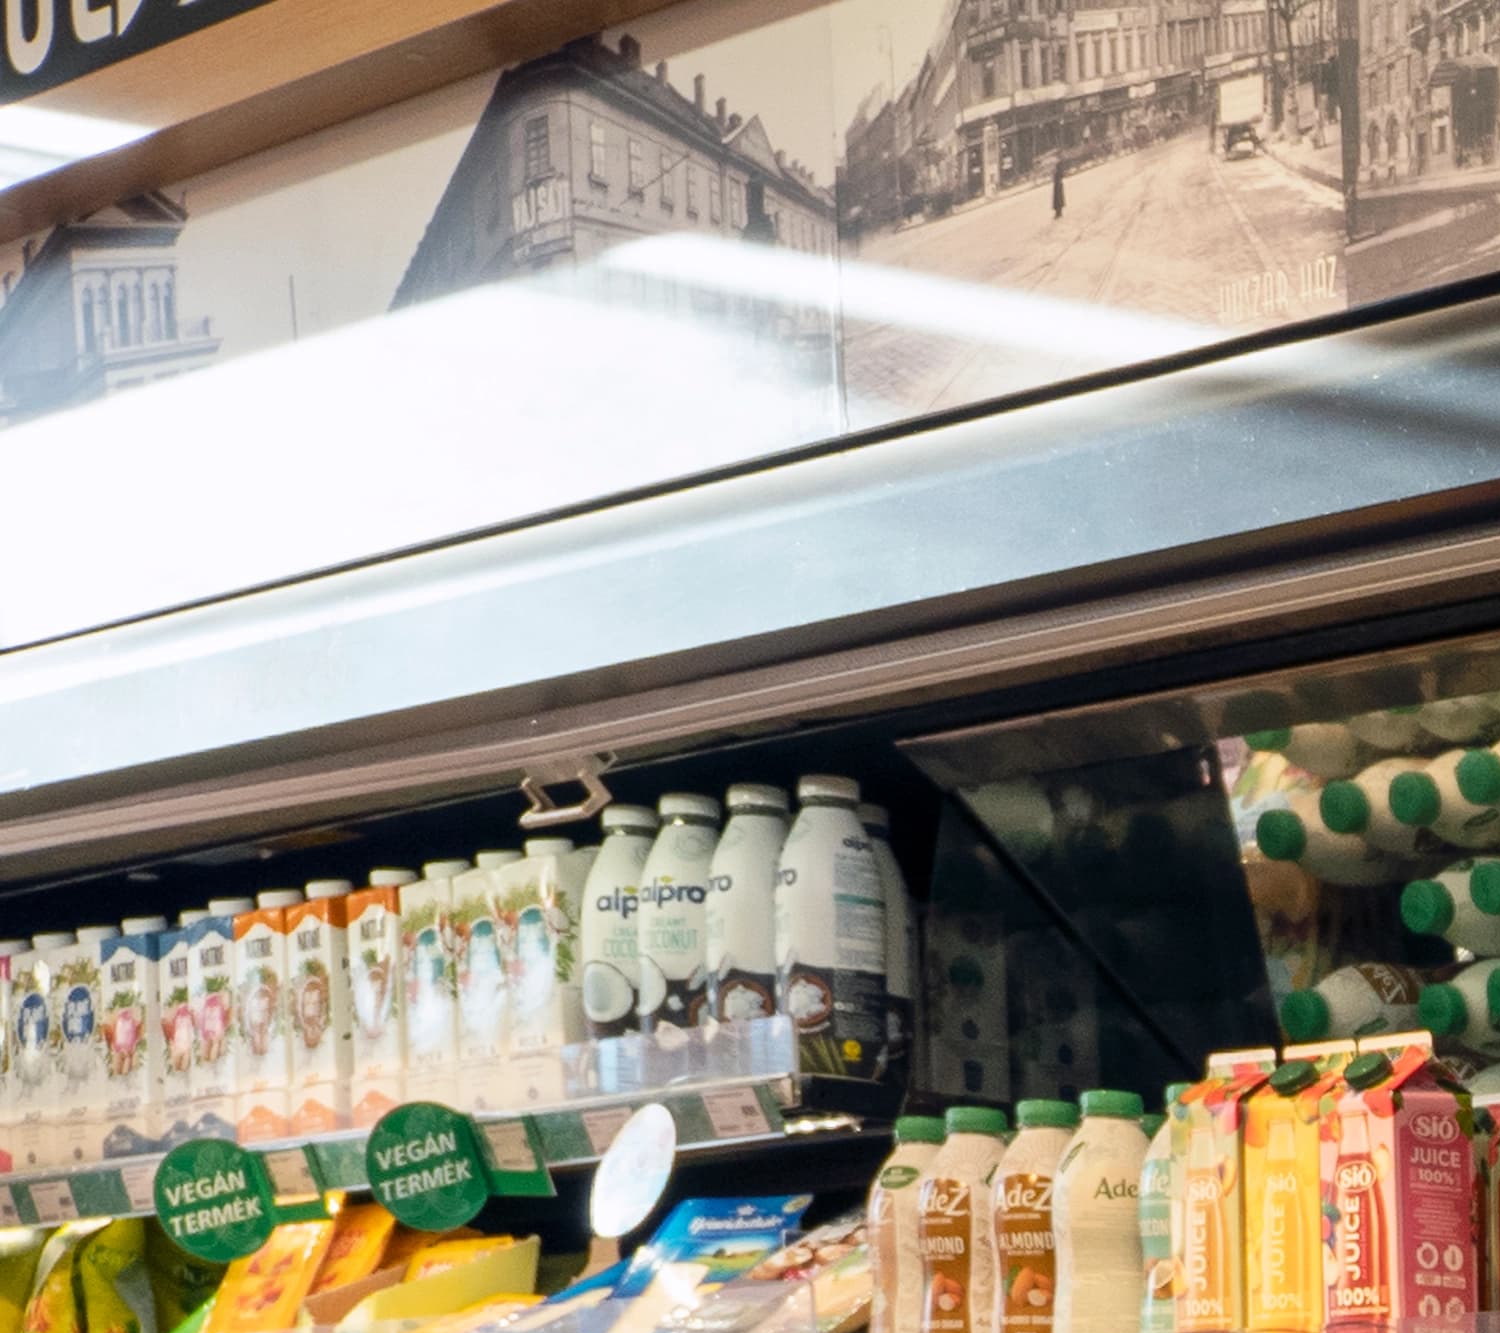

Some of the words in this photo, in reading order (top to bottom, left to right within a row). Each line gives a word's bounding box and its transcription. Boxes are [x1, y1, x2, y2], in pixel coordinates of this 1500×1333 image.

[1412, 1116, 1456, 1142] Sió
[377, 1131, 457, 1171] VEGÁN
[1409, 1145, 1462, 1168] JUICE
[165, 1168, 248, 1207] VEGÁN
[380, 1158, 473, 1201] TERMÉK
[1338, 1166, 1375, 1191] Sió
[1418, 1166, 1455, 1186] 100%
[170, 1196, 264, 1237] TERMÉK
[1344, 1195, 1362, 1281] JUICE
[1335, 1287, 1380, 1307] 100%
